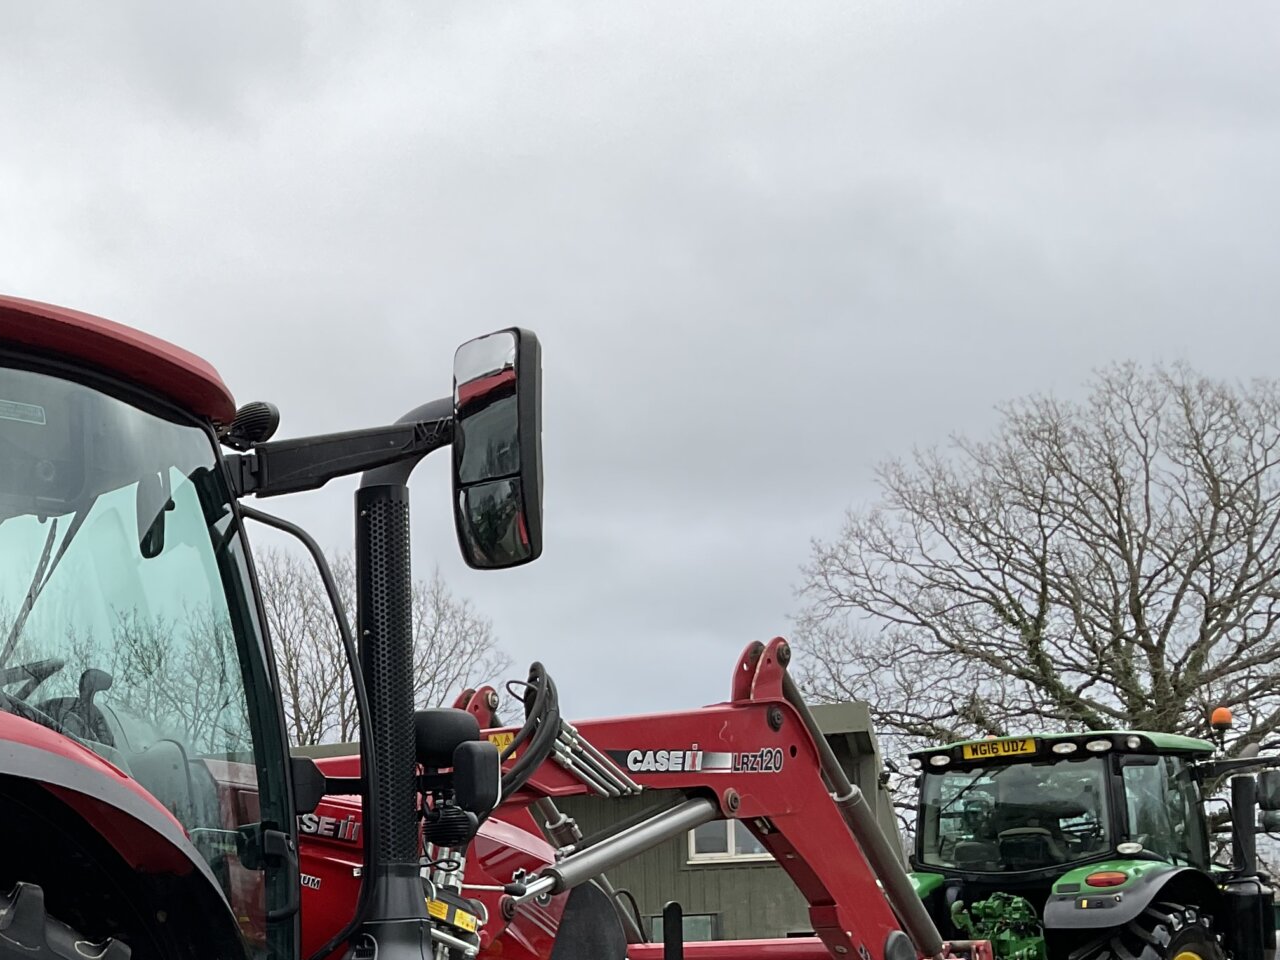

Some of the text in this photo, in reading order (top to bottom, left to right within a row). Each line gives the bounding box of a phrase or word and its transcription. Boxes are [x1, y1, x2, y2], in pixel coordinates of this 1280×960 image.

[970, 740, 1028, 756] WG16 UDZ
[626, 749, 683, 772] CASE
[732, 747, 784, 773] LRZ120
[296, 813, 337, 837] SE
[300, 873, 322, 890] UM
